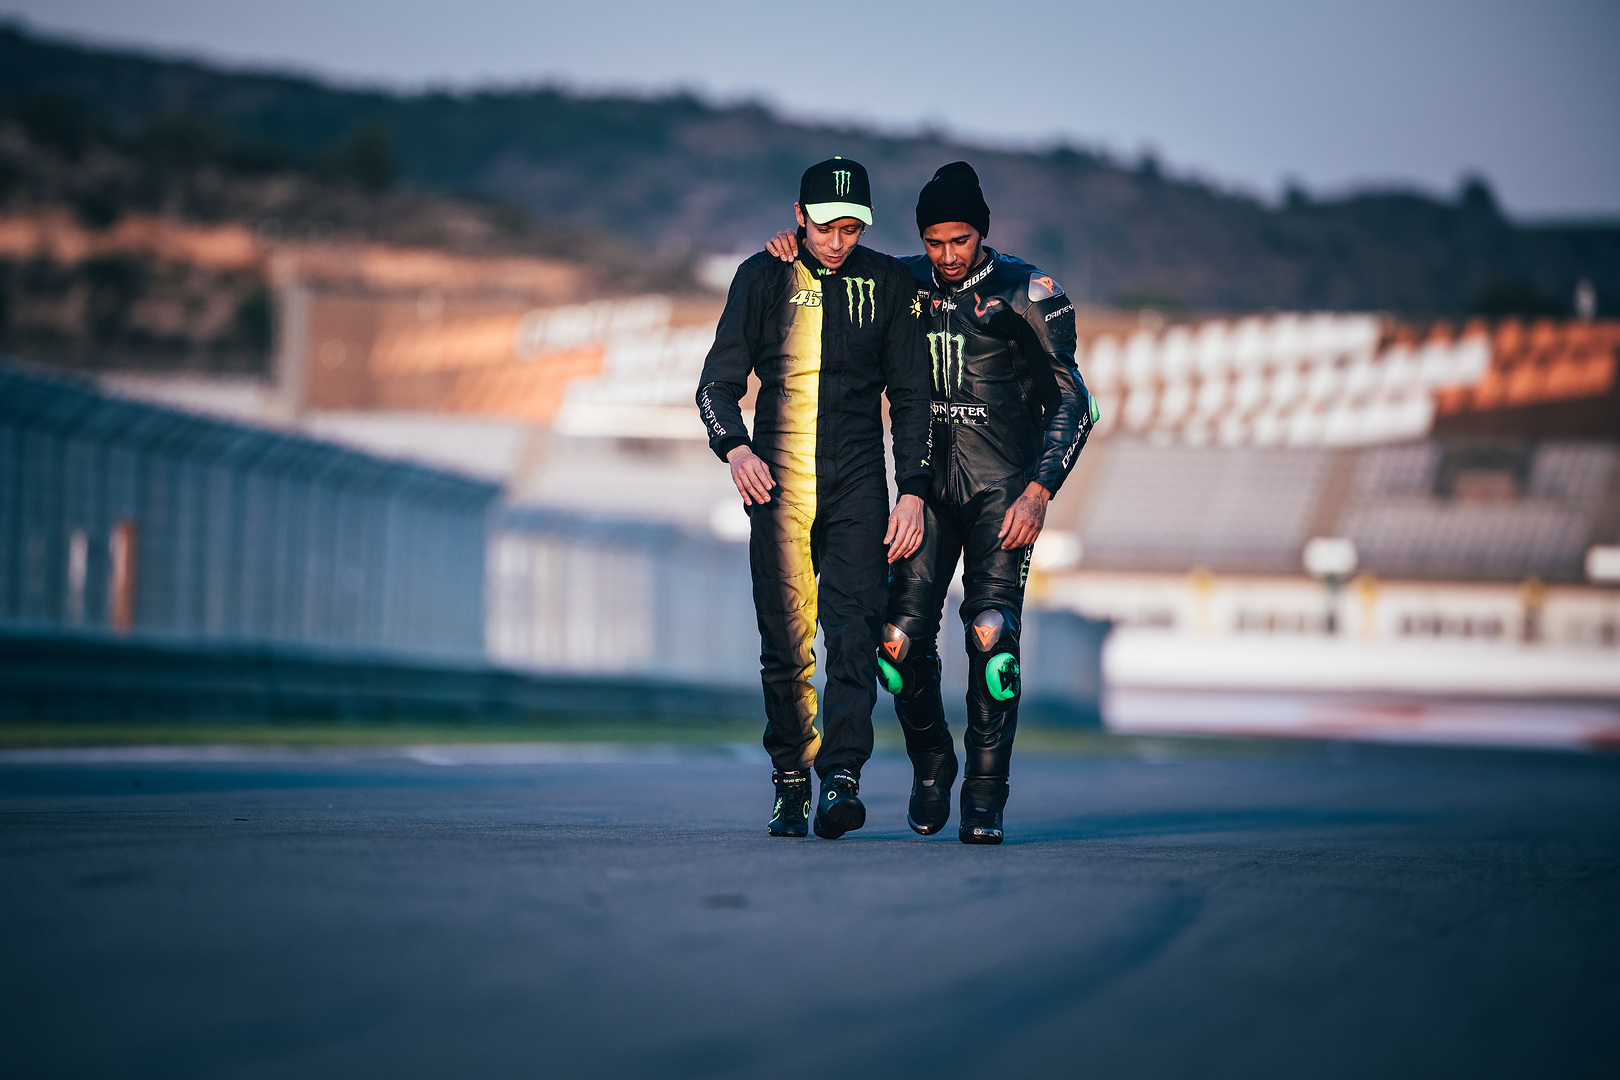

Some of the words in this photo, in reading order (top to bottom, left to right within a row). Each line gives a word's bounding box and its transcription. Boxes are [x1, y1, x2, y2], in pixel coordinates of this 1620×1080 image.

[957, 259, 994, 292] BOSE
[788, 289, 823, 307] 46
[701, 389, 727, 437] MONSTER
[932, 402, 988, 418] ONSTER
